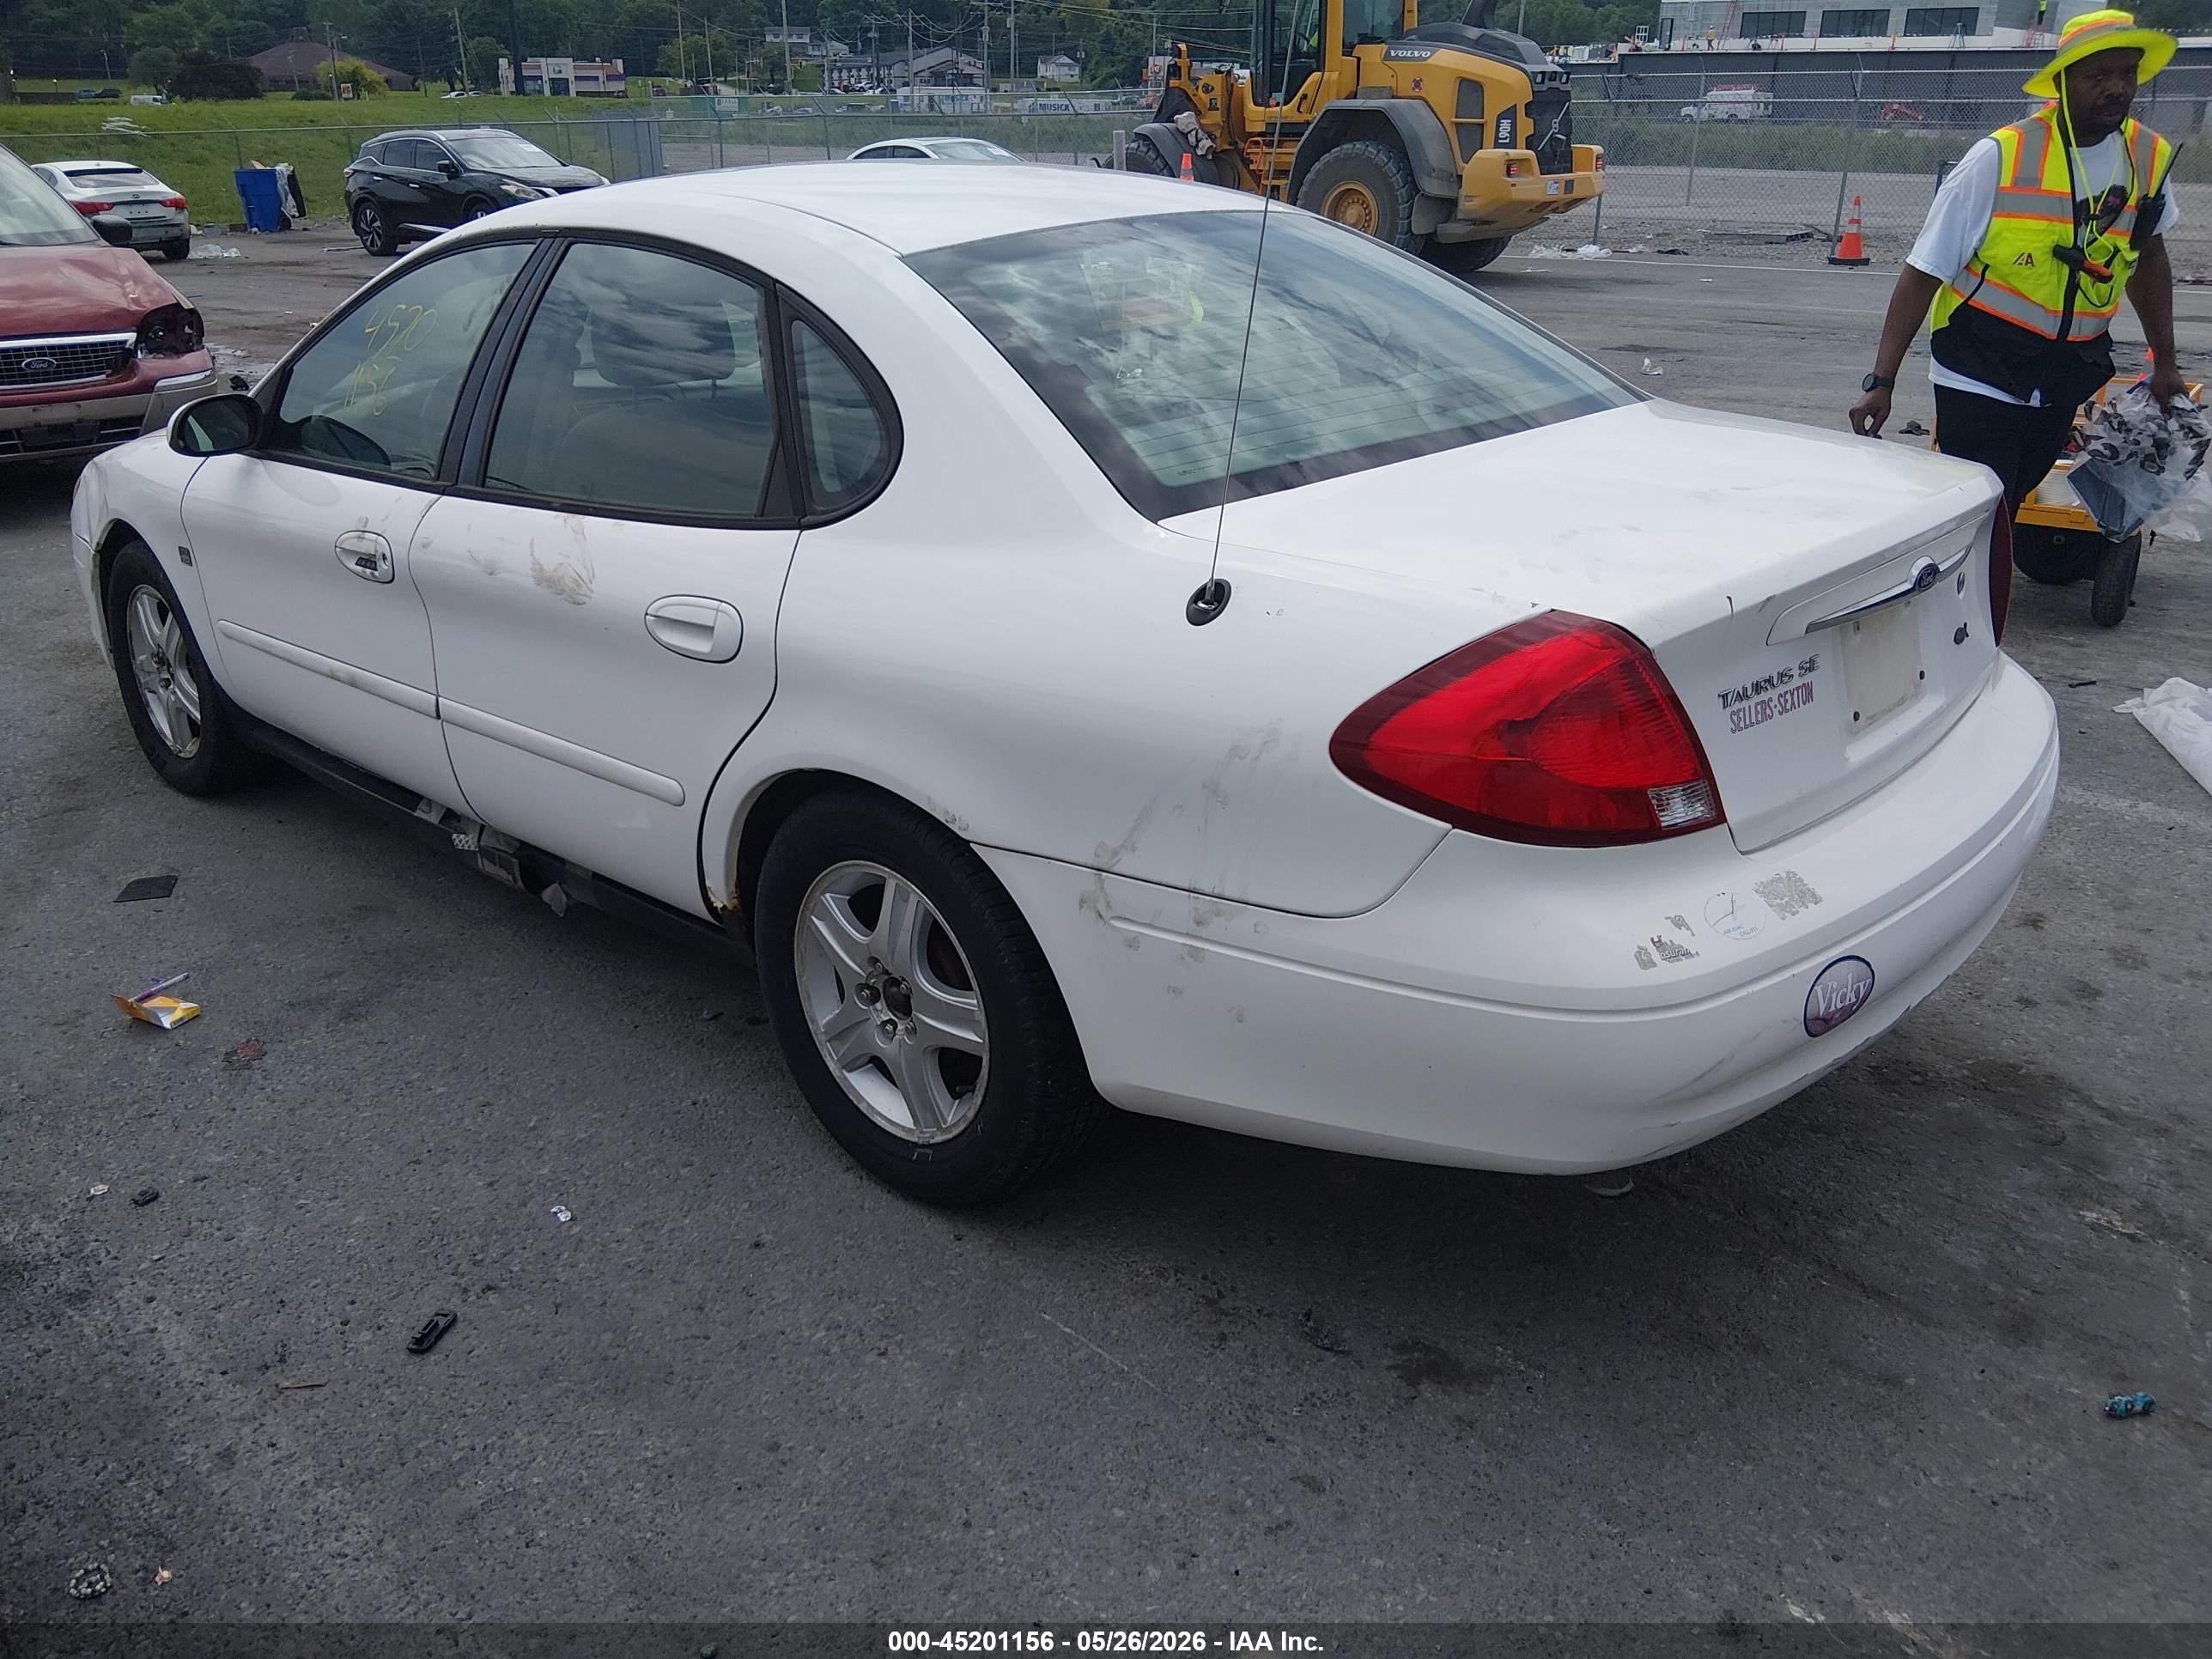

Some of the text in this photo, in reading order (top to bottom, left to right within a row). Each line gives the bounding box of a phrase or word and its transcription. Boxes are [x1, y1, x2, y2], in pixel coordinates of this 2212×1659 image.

[1389, 49, 1431, 58] VOLVO
[1038, 102, 1070, 112] MUSICK
[1498, 119, 1512, 143] L90H
[365, 304, 438, 352] 4520
[1717, 653, 1820, 710] TAURUS SE
[1814, 972, 1871, 1018] Vicky
